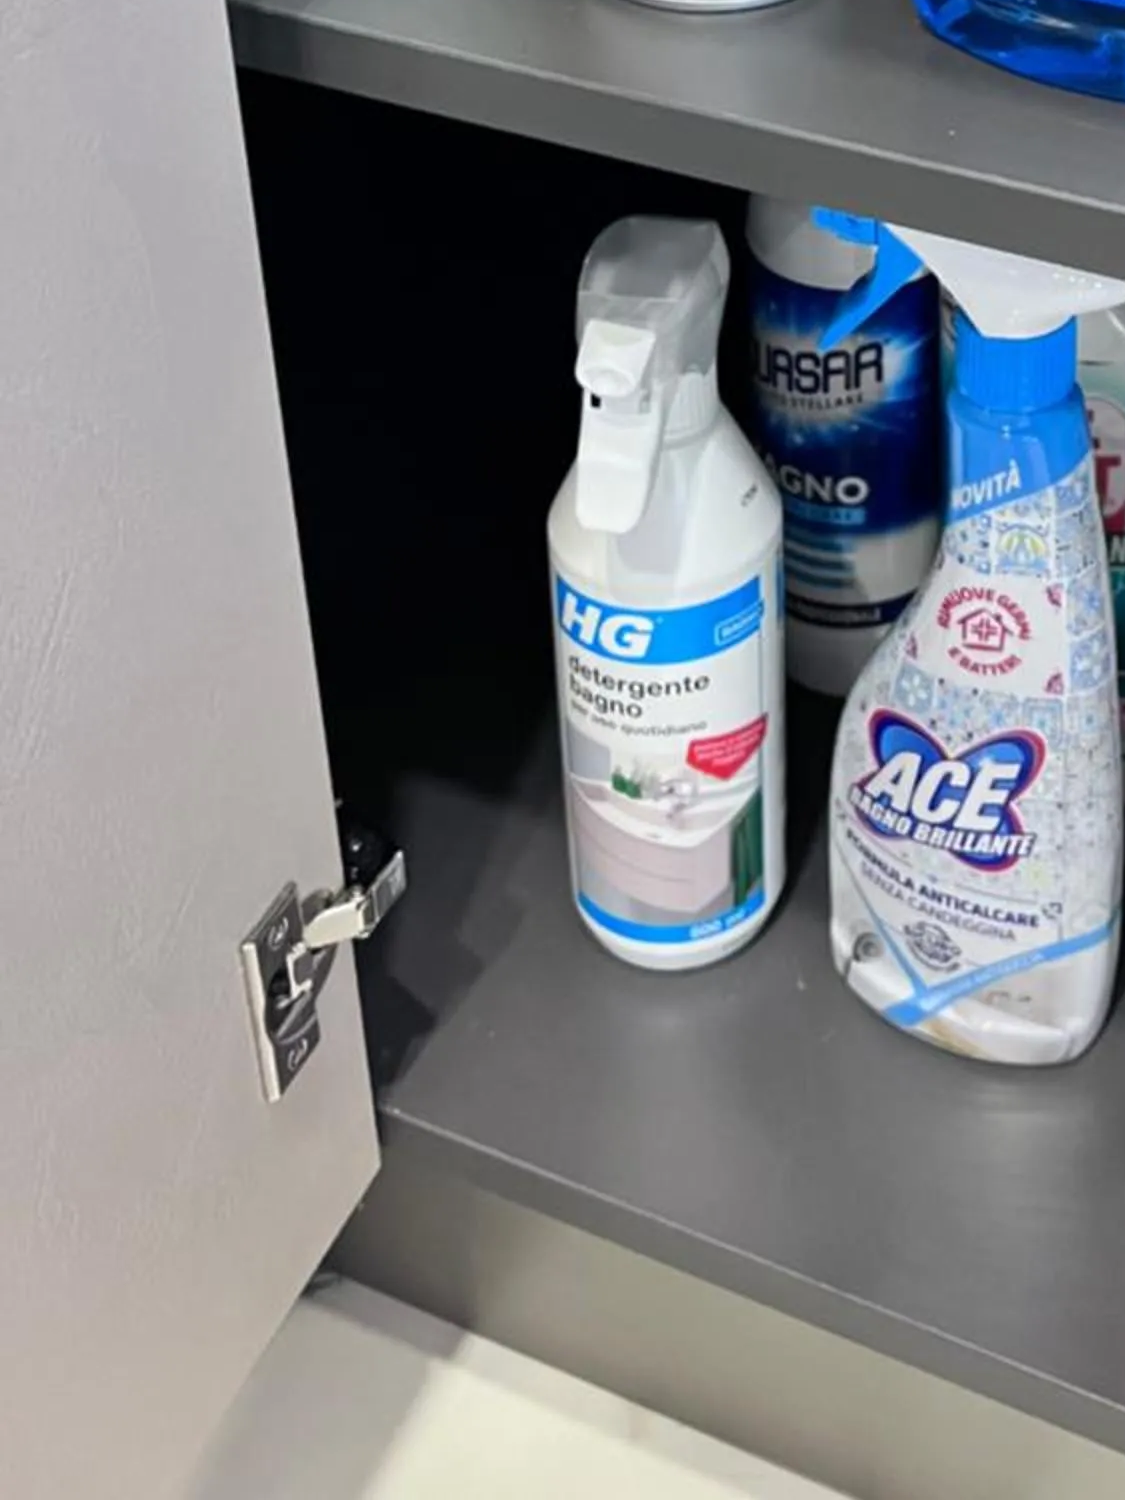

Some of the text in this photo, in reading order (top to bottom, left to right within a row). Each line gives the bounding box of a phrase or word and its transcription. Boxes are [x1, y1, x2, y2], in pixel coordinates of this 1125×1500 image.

[561, 592, 655, 659] HG
[936, 586, 1033, 641] RIMUOVE GERMI
[568, 654, 711, 701] detergente
[959, 653, 1022, 676] BATTERI
[568, 673, 644, 719] bagno
[864, 751, 1020, 833] ACE
[912, 826, 1037, 858] BRILLANTE
[846, 830, 1040, 928] FORMULA ANTICALCARE
[859, 861, 1017, 942] SENZA CANDEGGINA
